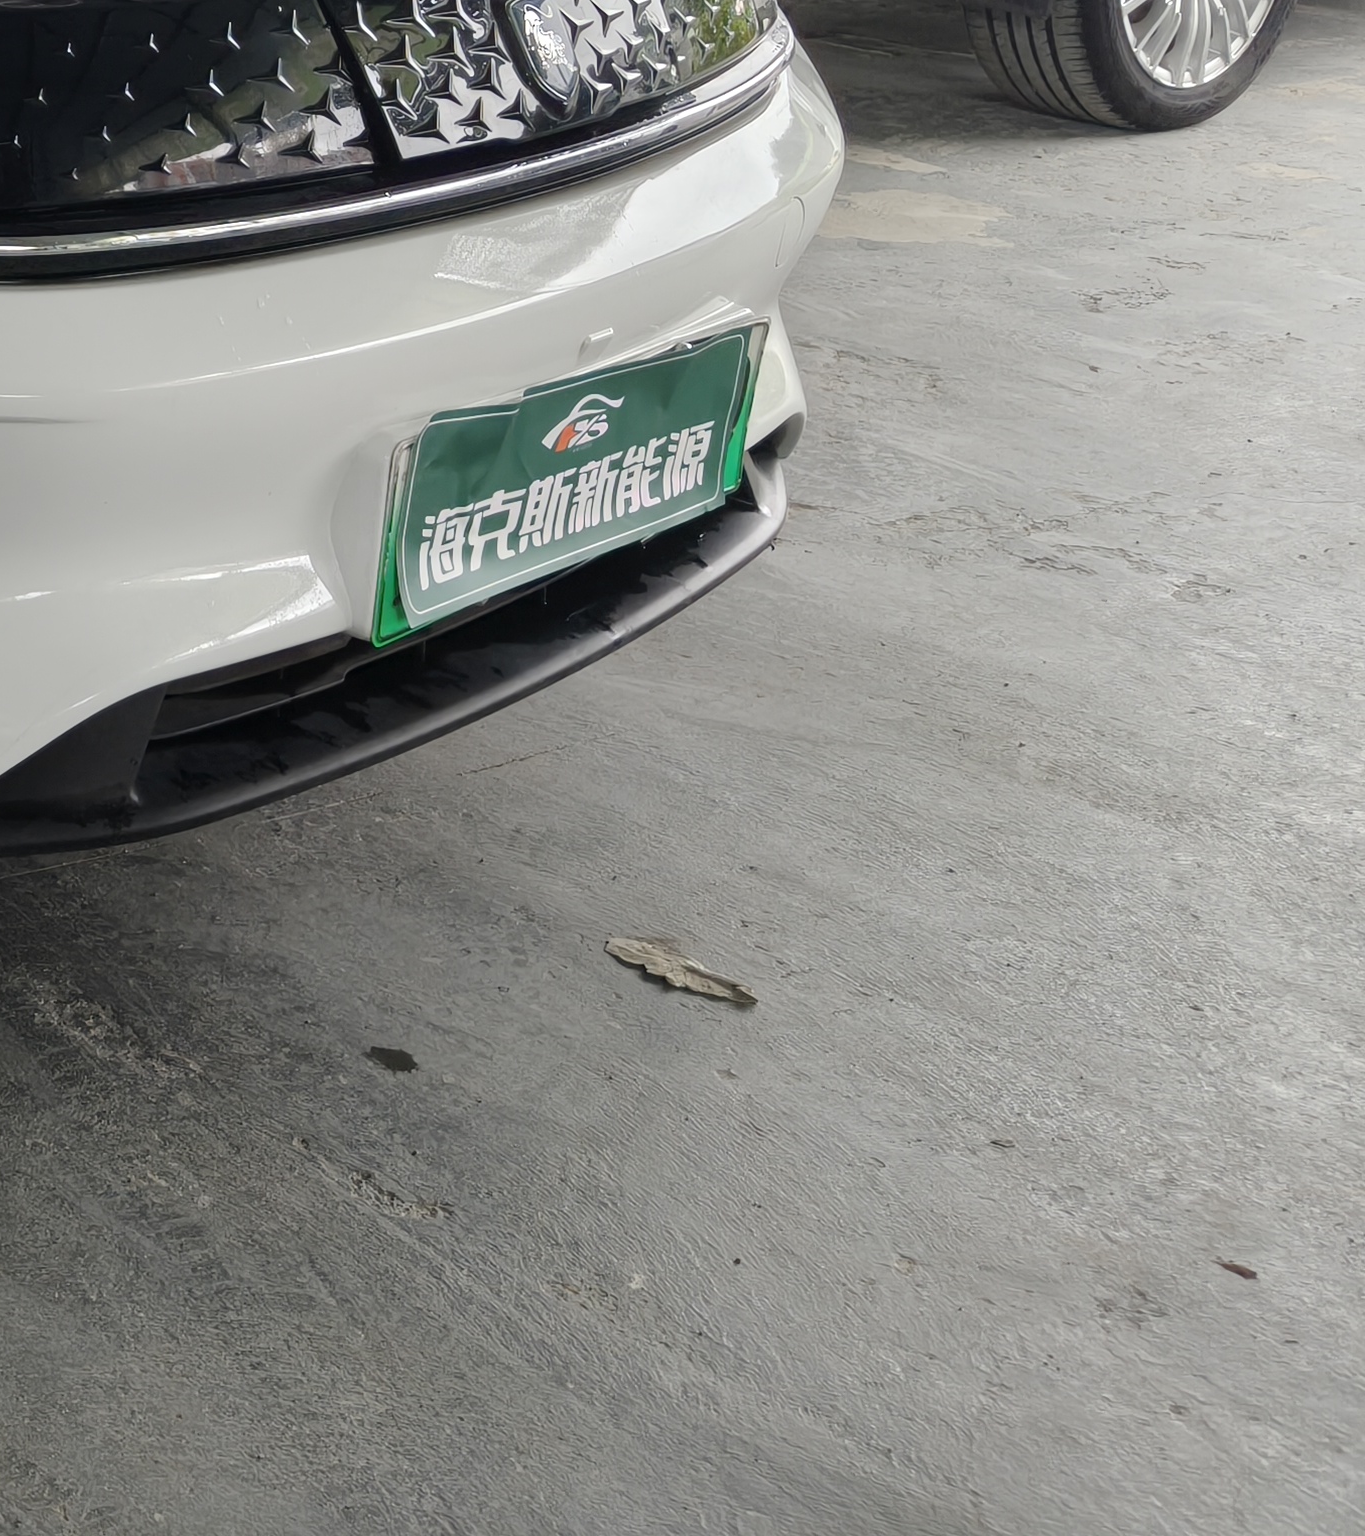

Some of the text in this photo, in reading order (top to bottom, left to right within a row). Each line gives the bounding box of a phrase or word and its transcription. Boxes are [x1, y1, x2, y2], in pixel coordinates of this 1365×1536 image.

[419, 420, 714, 591] 海克斯新能源
